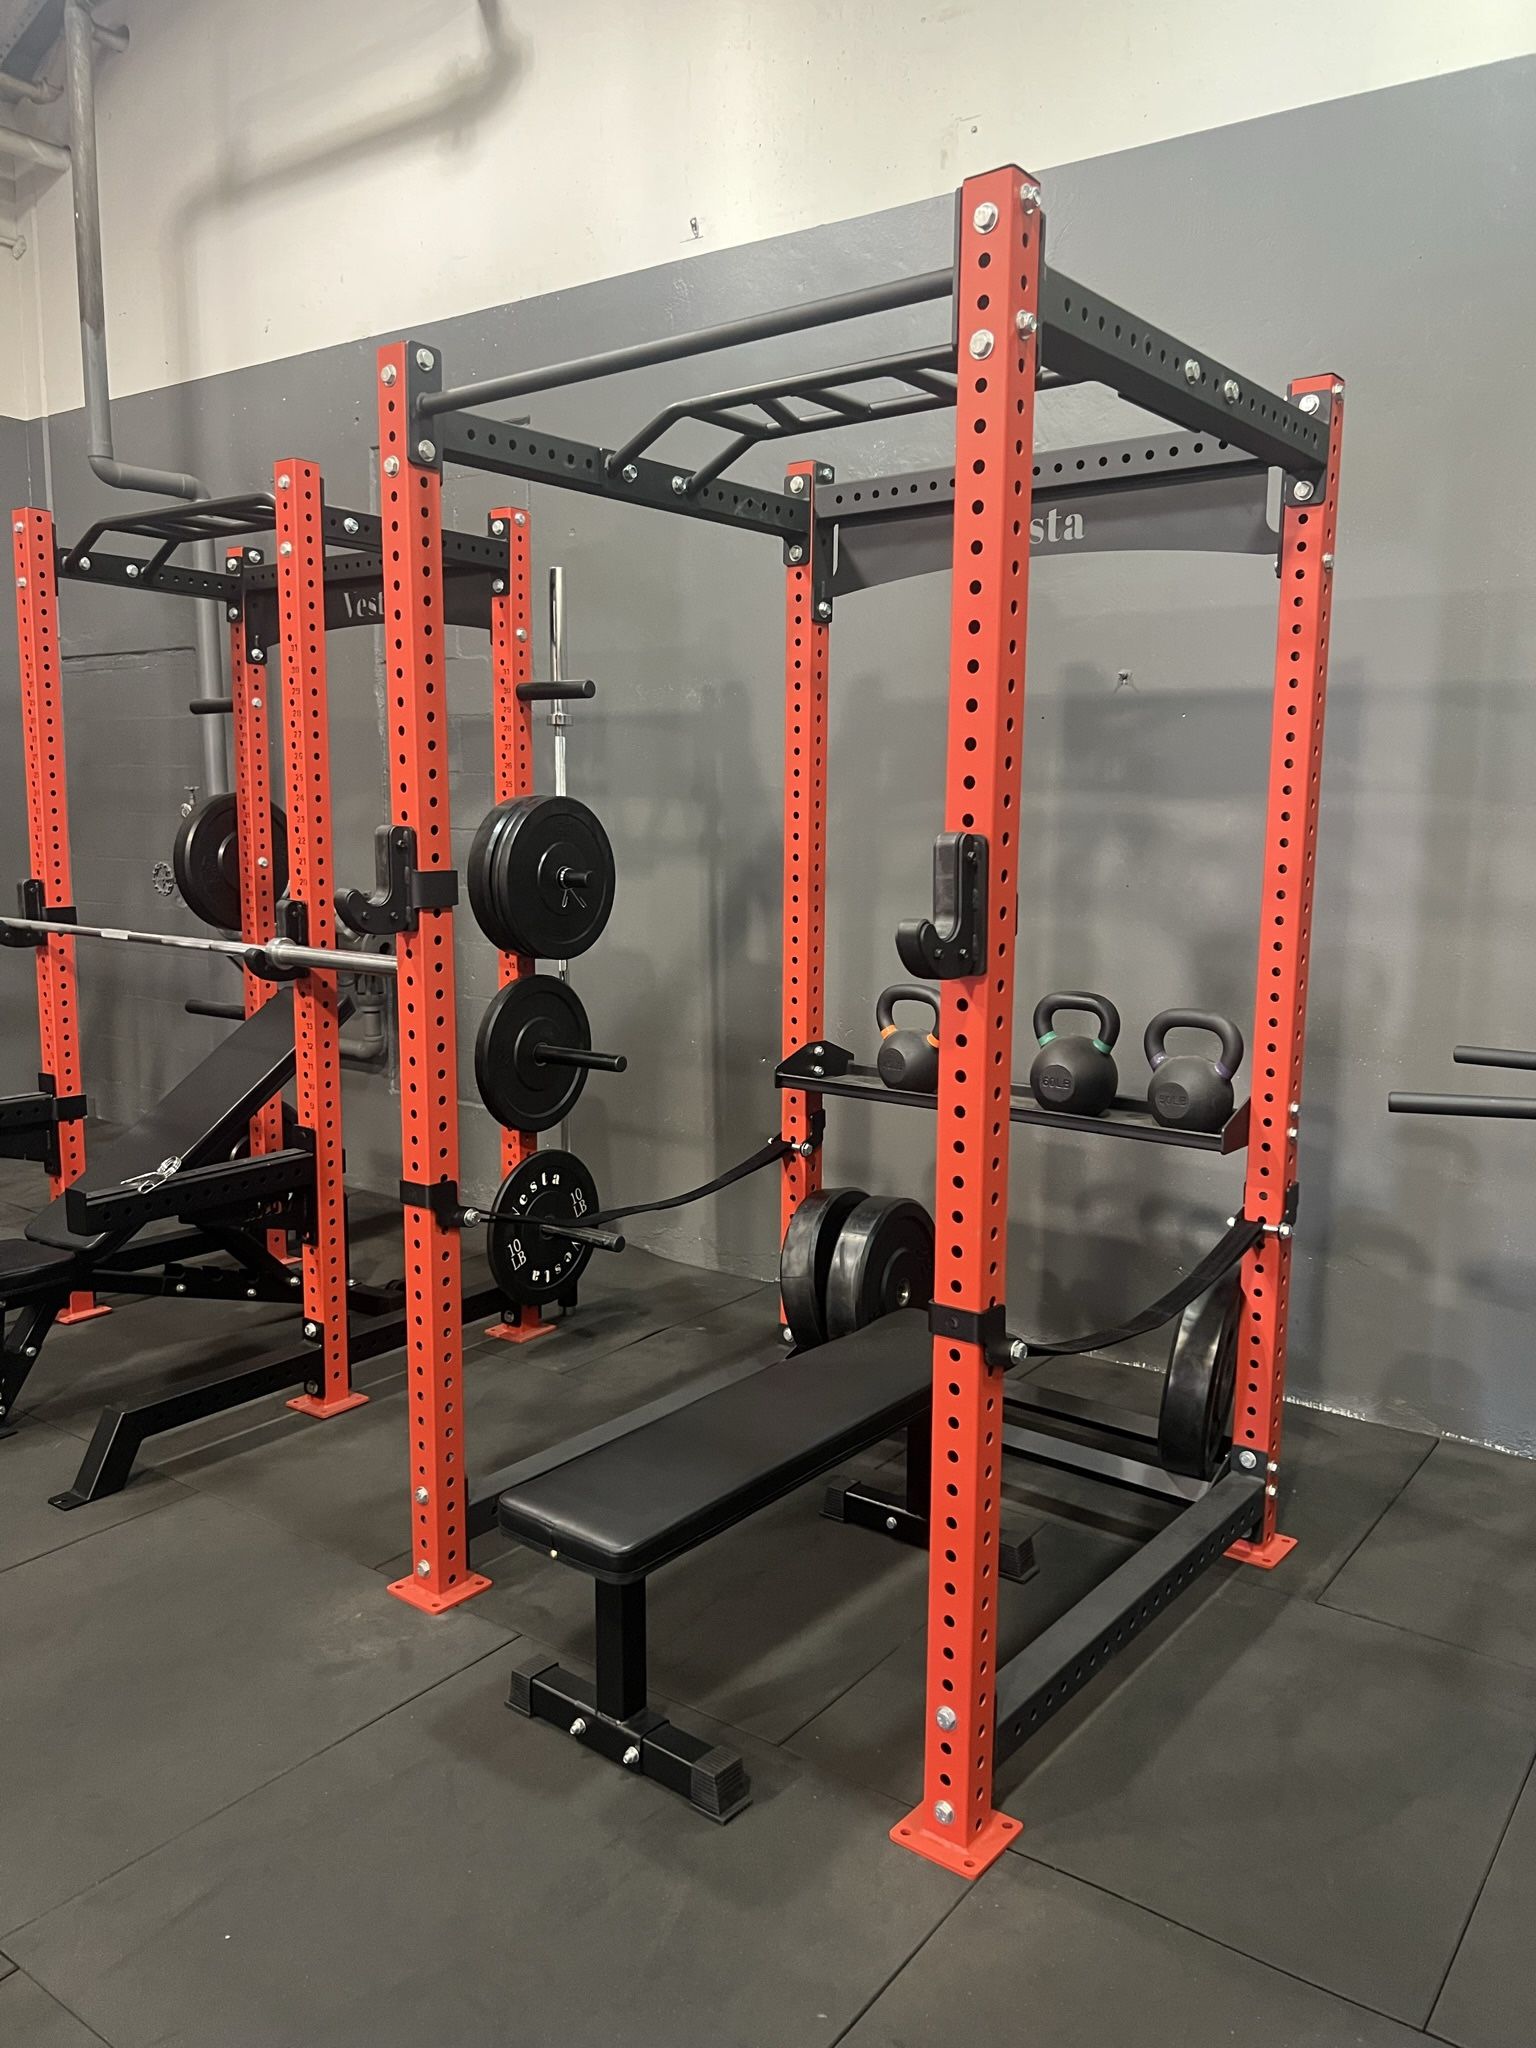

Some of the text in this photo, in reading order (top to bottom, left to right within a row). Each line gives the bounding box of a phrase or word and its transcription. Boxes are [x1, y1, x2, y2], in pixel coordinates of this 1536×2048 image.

[1029, 508, 1085, 544] sta
[343, 591, 384, 618] Vest
[570, 1187, 583, 1206] 10
[573, 1199, 588, 1219] LB
[507, 1238, 521, 1258] 10
[511, 1250, 527, 1271] LB
